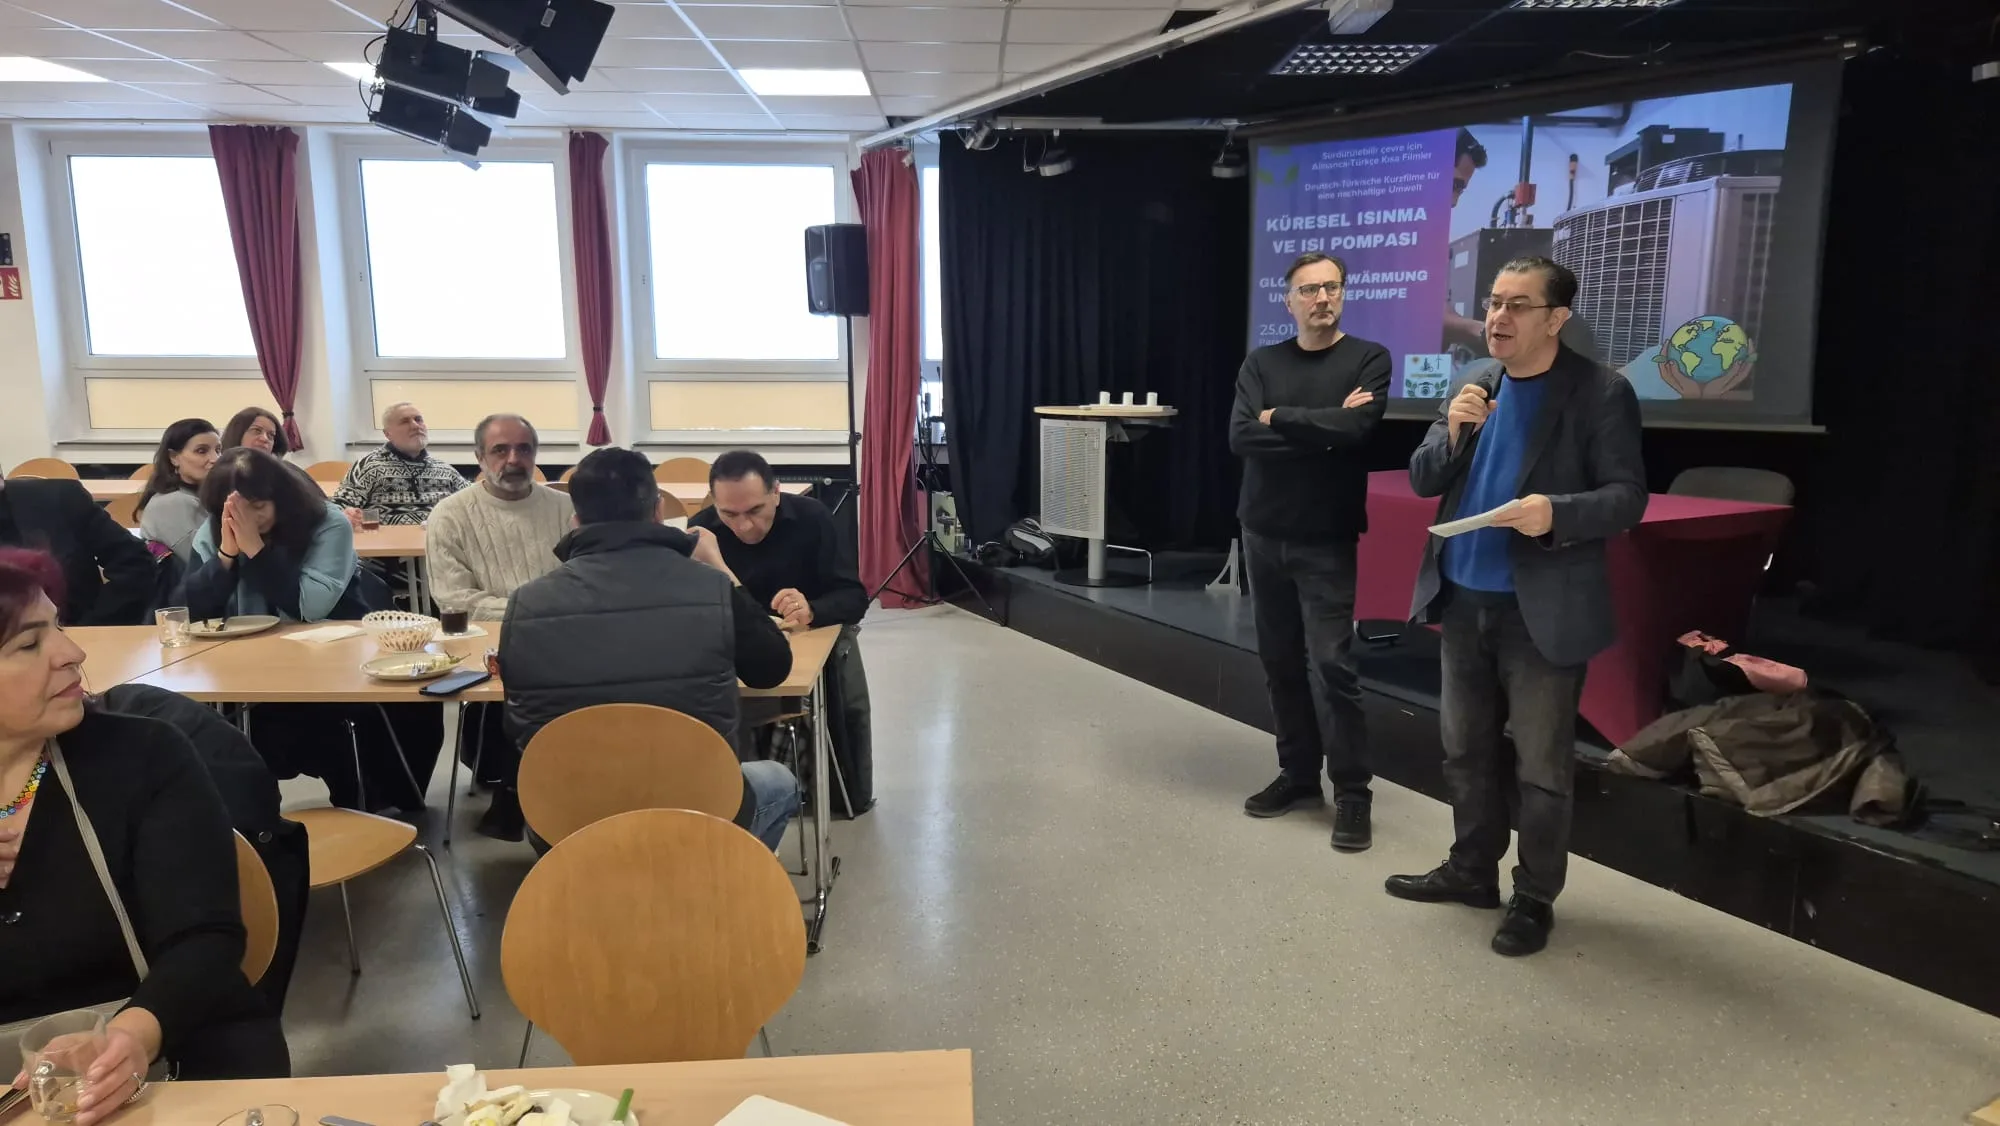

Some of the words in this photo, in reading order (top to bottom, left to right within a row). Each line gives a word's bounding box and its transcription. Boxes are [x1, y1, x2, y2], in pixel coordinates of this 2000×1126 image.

[1402, 151, 1432, 161] Filmler
[1384, 173, 1425, 184] Kurzfilme
[1427, 171, 1440, 180] für
[1318, 191, 1335, 200] eine
[1337, 187, 1386, 198] nachhaltige
[1388, 184, 1422, 193] Umwelt
[1266, 213, 1350, 232] KÜRESEL
[1357, 207, 1427, 225] ISINMA
[1273, 239, 1296, 253] VE
[1301, 237, 1324, 251] ISI
[1331, 231, 1418, 250] POMPASI
[1345, 270, 1428, 286] WÄRMUNG
[1259, 323, 1298, 336] 25.01.
